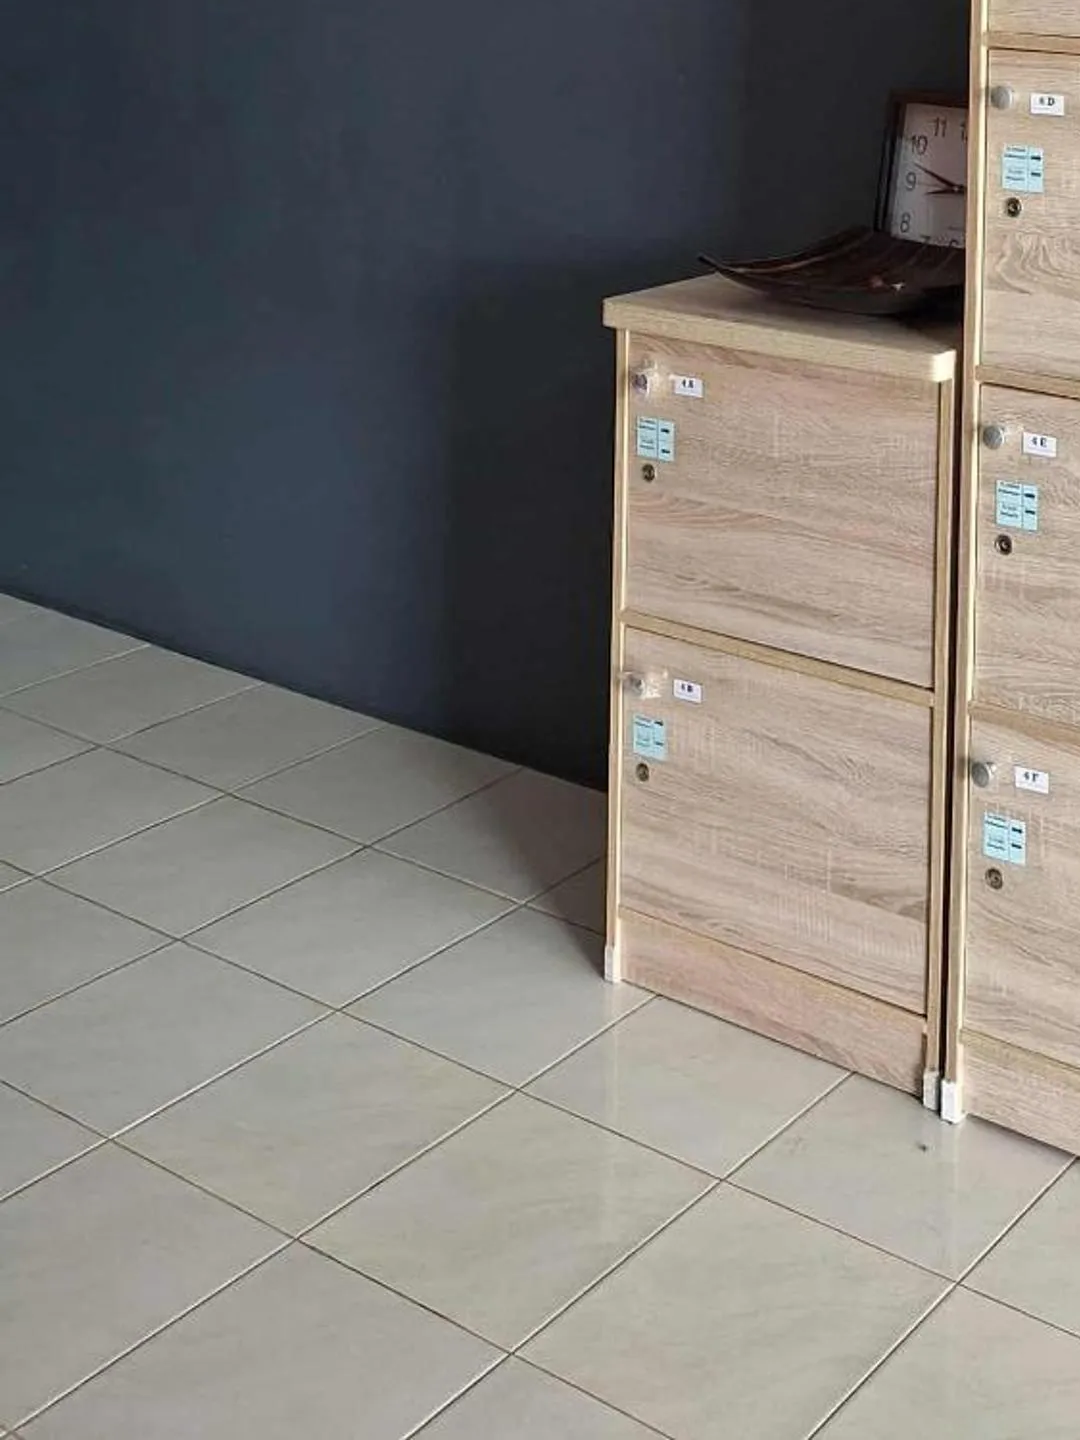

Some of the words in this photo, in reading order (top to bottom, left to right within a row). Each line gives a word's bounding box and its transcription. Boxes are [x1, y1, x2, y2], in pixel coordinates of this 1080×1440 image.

[934, 116, 948, 137] 11
[911, 135, 928, 155] 10
[905, 172, 916, 191] 9
[900, 213, 911, 233] 8
